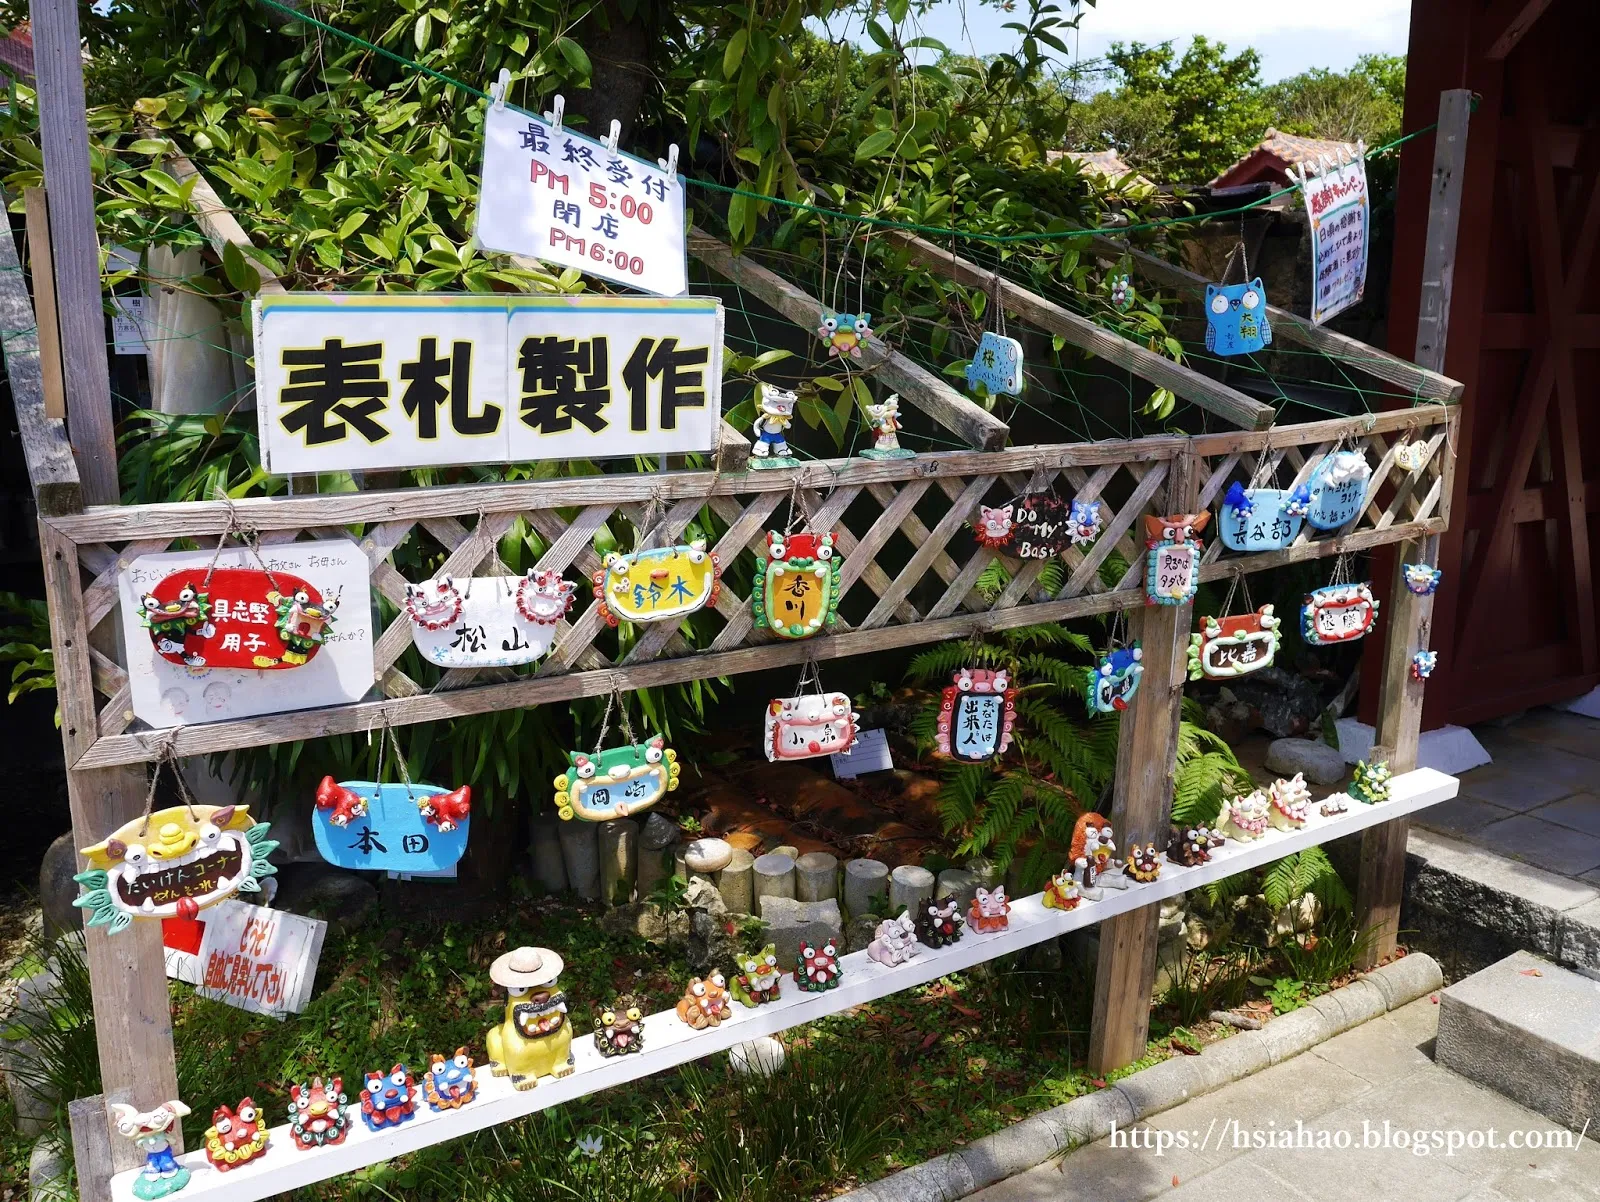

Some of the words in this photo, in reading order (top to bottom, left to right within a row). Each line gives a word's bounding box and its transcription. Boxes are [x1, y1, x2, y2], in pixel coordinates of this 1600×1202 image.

[518, 121, 671, 202] 最終受付
[529, 159, 570, 196] PM
[588, 182, 654, 226] 5:00
[552, 199, 620, 240] 閉店
[281, 336, 711, 447] 表札製作
[1232, 517, 1292, 545] 長谷部
[1163, 554, 1189, 571] 見るのは
[632, 575, 694, 609] 鈴木
[783, 574, 810, 621] 香川
[449, 622, 530, 653] 松山
[1217, 641, 1257, 667] 比嘉
[982, 698, 995, 743] あなたは
[591, 780, 646, 806] 岡崎
[347, 825, 429, 855] 本田
